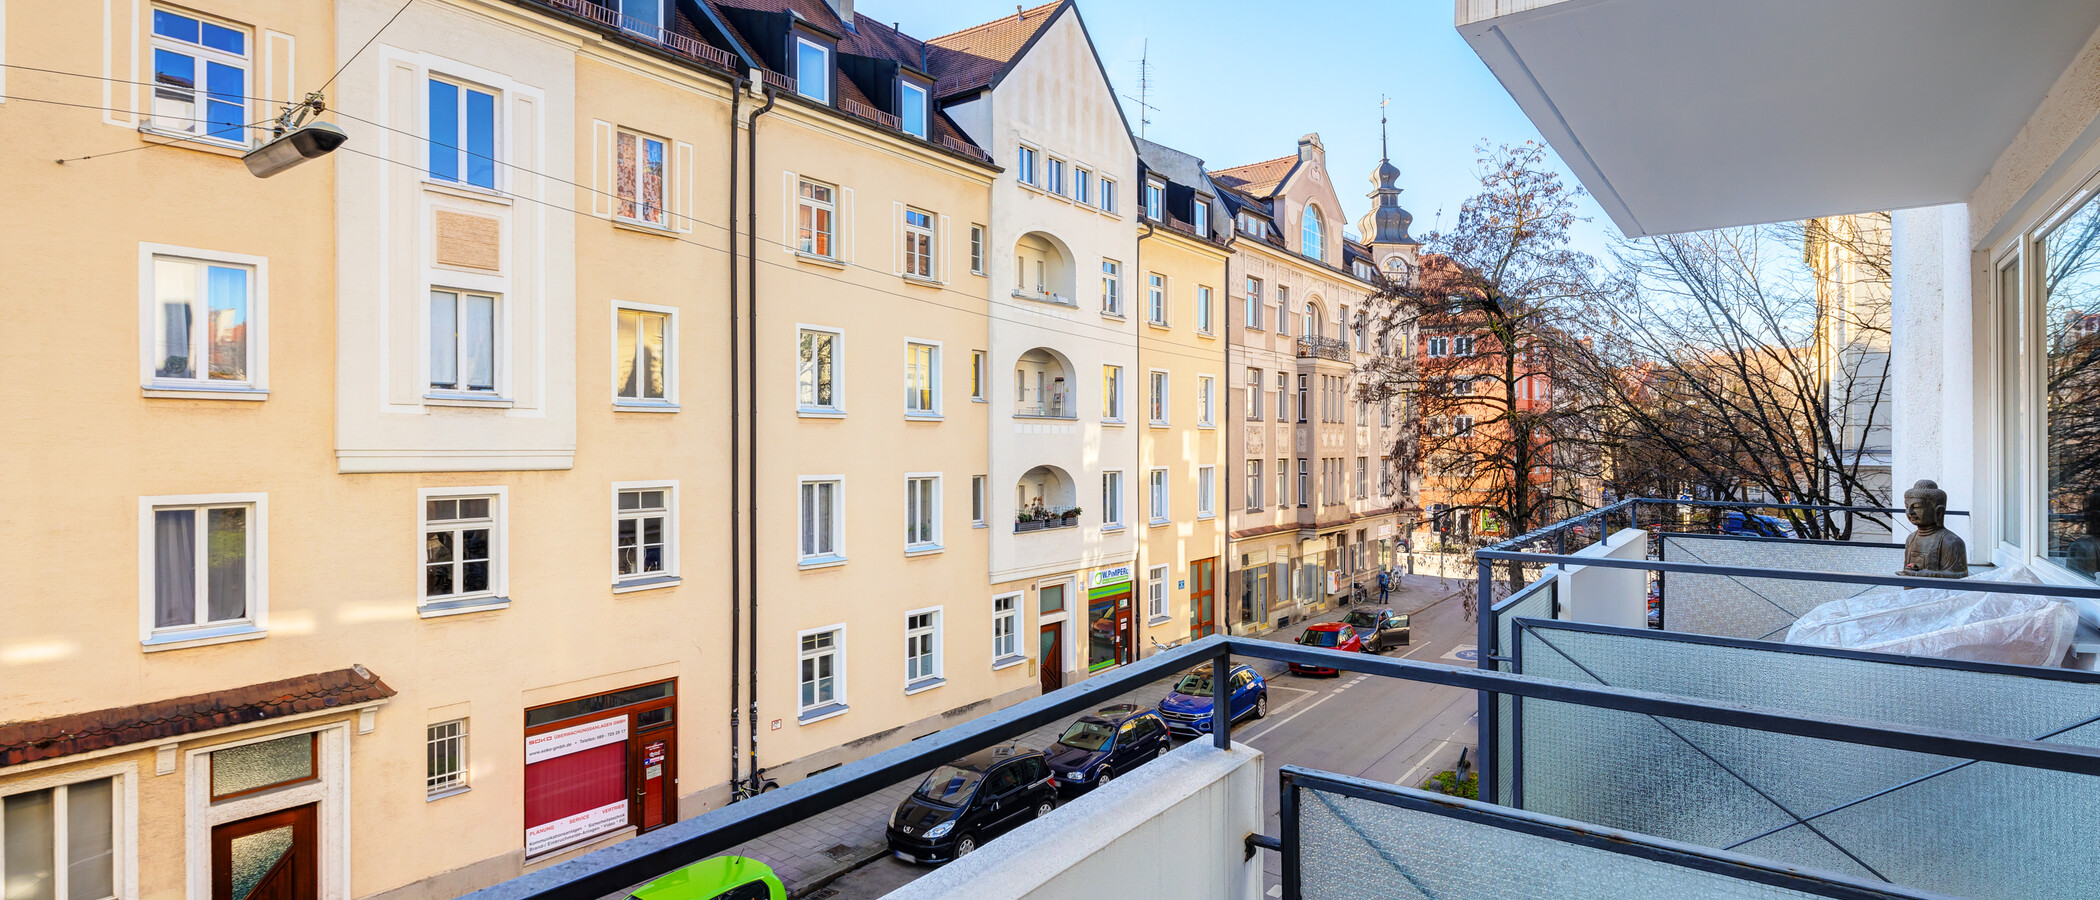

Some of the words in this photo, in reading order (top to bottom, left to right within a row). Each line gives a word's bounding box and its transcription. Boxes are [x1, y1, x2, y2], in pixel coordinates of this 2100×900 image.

[529, 736, 552, 745] SOKO
[529, 825, 554, 836] PLANUNG
[569, 814, 590, 824] SERVICE
[602, 803, 625, 814] VERTRIEB
[529, 827, 582, 846] Kommunikationsanlagen
[588, 813, 625, 828] Sicherheitstechnik
